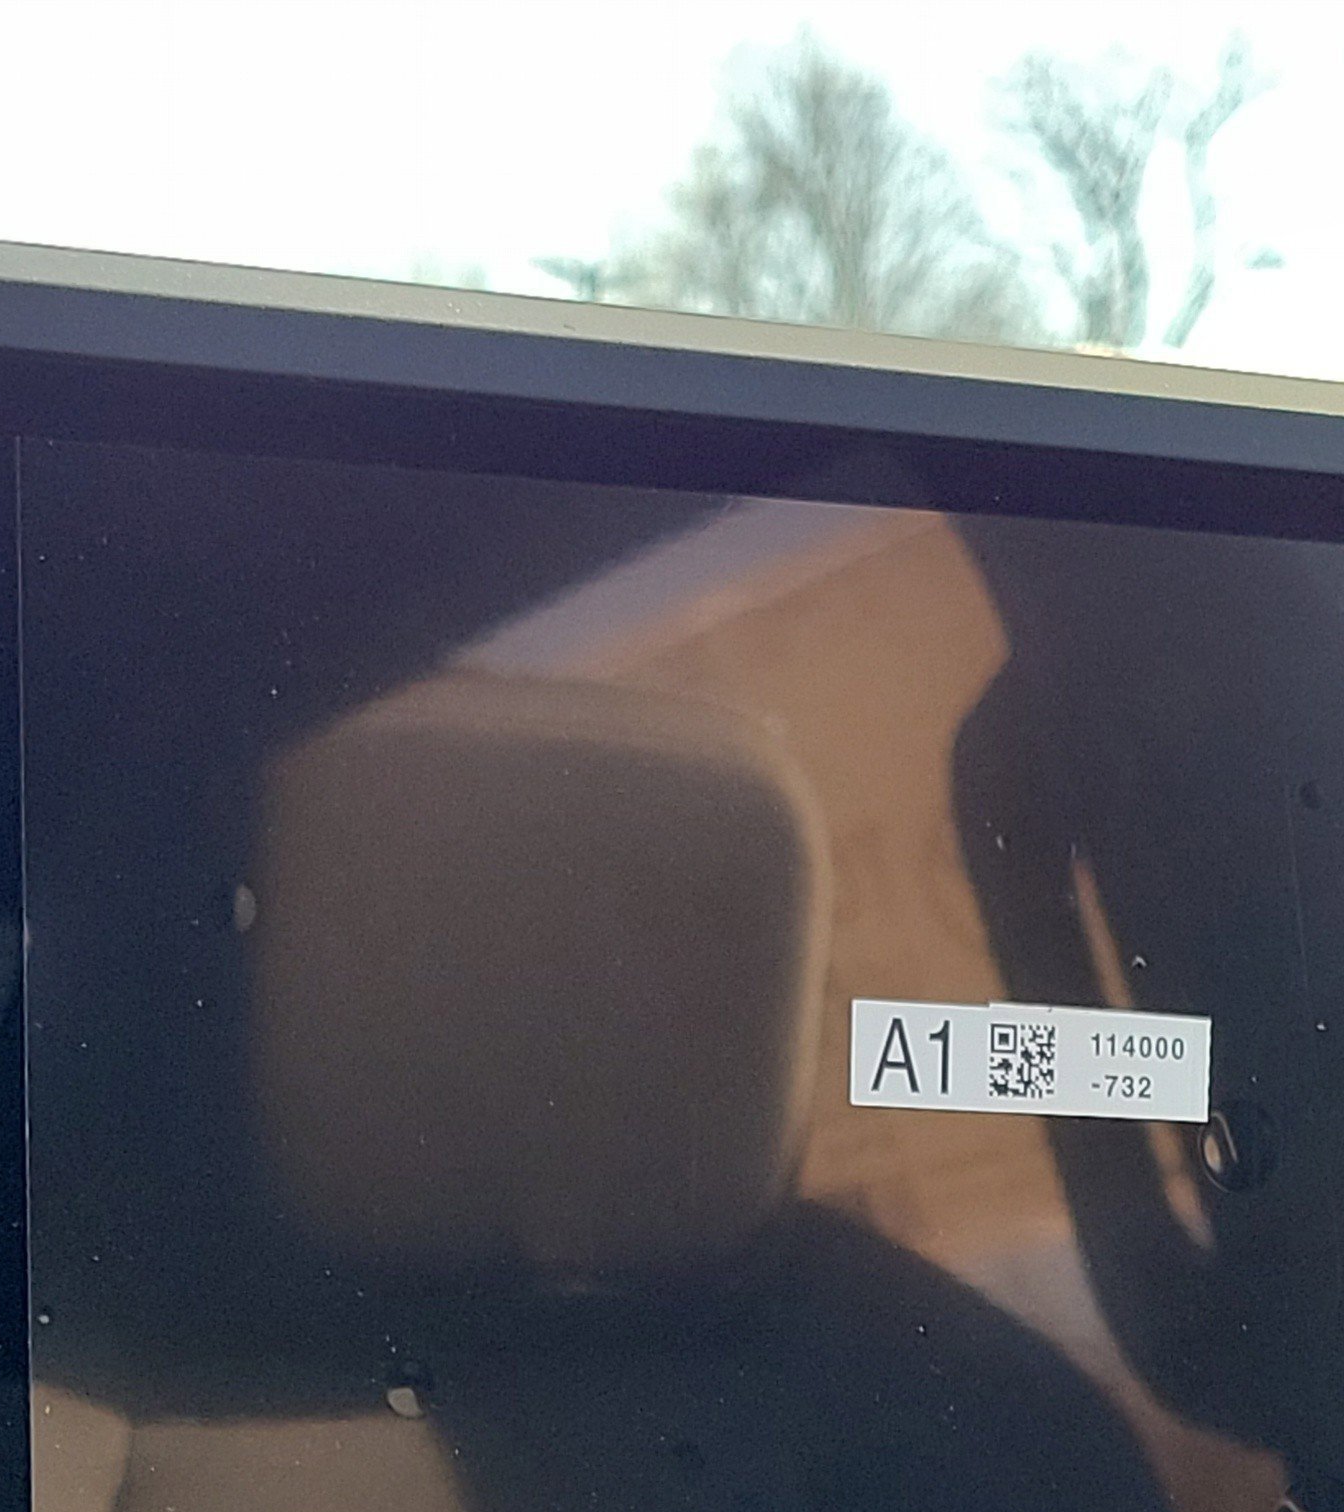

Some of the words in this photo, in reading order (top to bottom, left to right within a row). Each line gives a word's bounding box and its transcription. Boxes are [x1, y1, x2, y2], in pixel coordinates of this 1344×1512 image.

[870, 1015, 952, 1096] A1
[1089, 1032, 1186, 1061] 114000
[1091, 1074, 1152, 1100] -732
